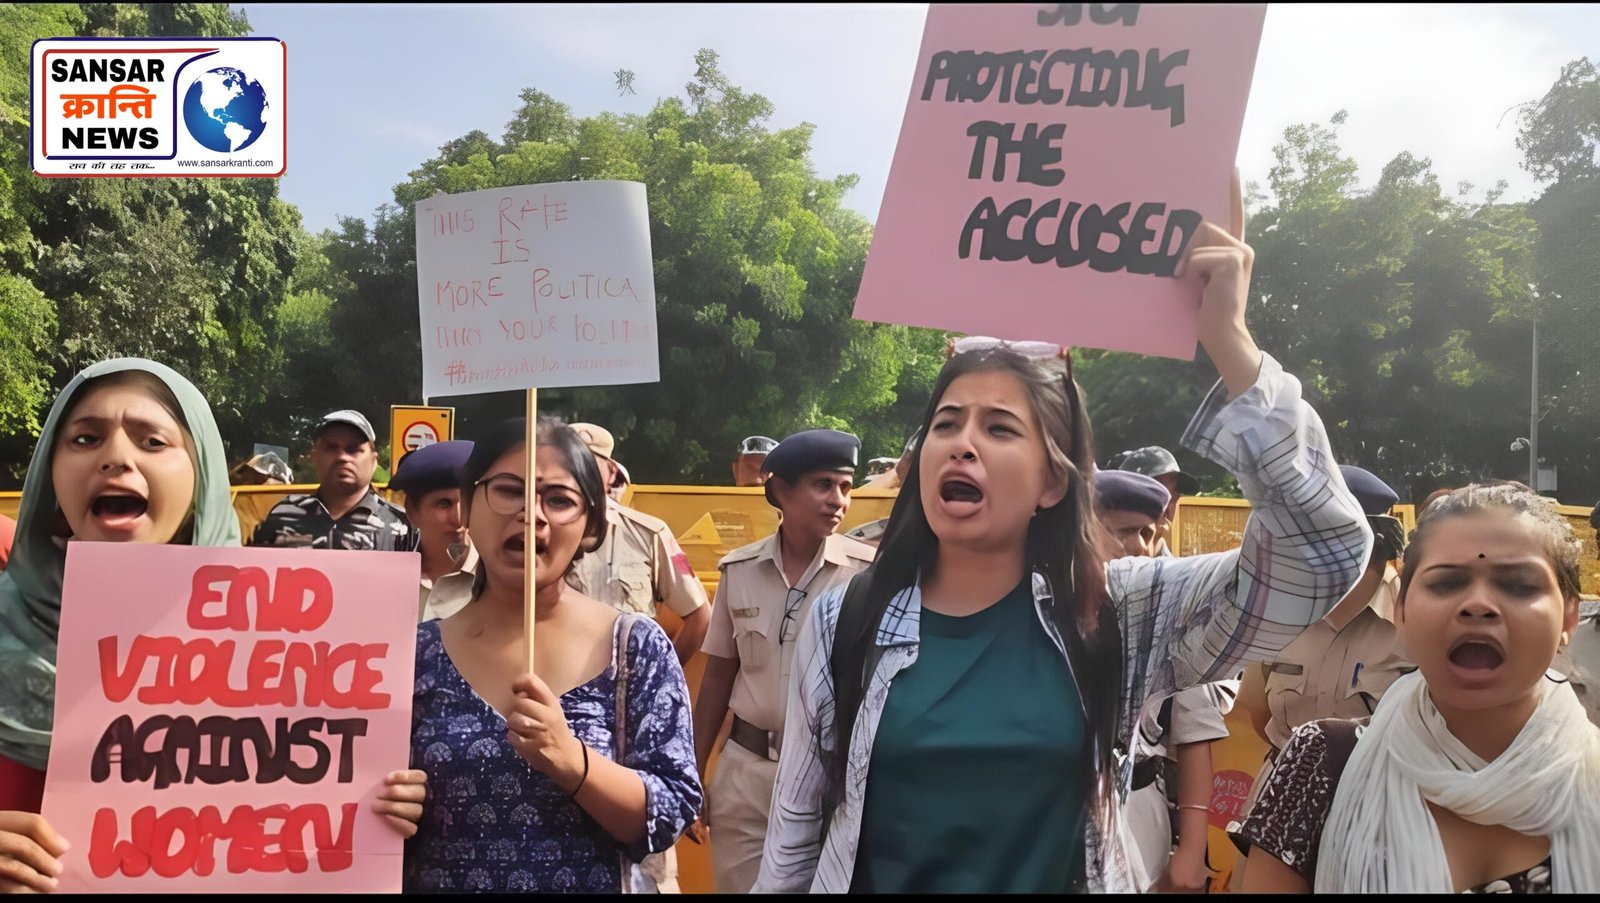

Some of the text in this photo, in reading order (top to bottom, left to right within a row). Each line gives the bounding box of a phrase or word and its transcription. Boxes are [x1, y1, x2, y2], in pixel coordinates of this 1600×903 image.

[921, 48, 1190, 128] PROTECTING
[966, 120, 1067, 187] THE
[492, 239, 531, 265] IS
[958, 196, 1204, 278] ACCUSED
[436, 276, 503, 312] MORE
[186, 565, 333, 633] END
[98, 634, 391, 710] VIOLENCE
[90, 714, 368, 790] AGAINST
[88, 803, 358, 878] WOMEN
